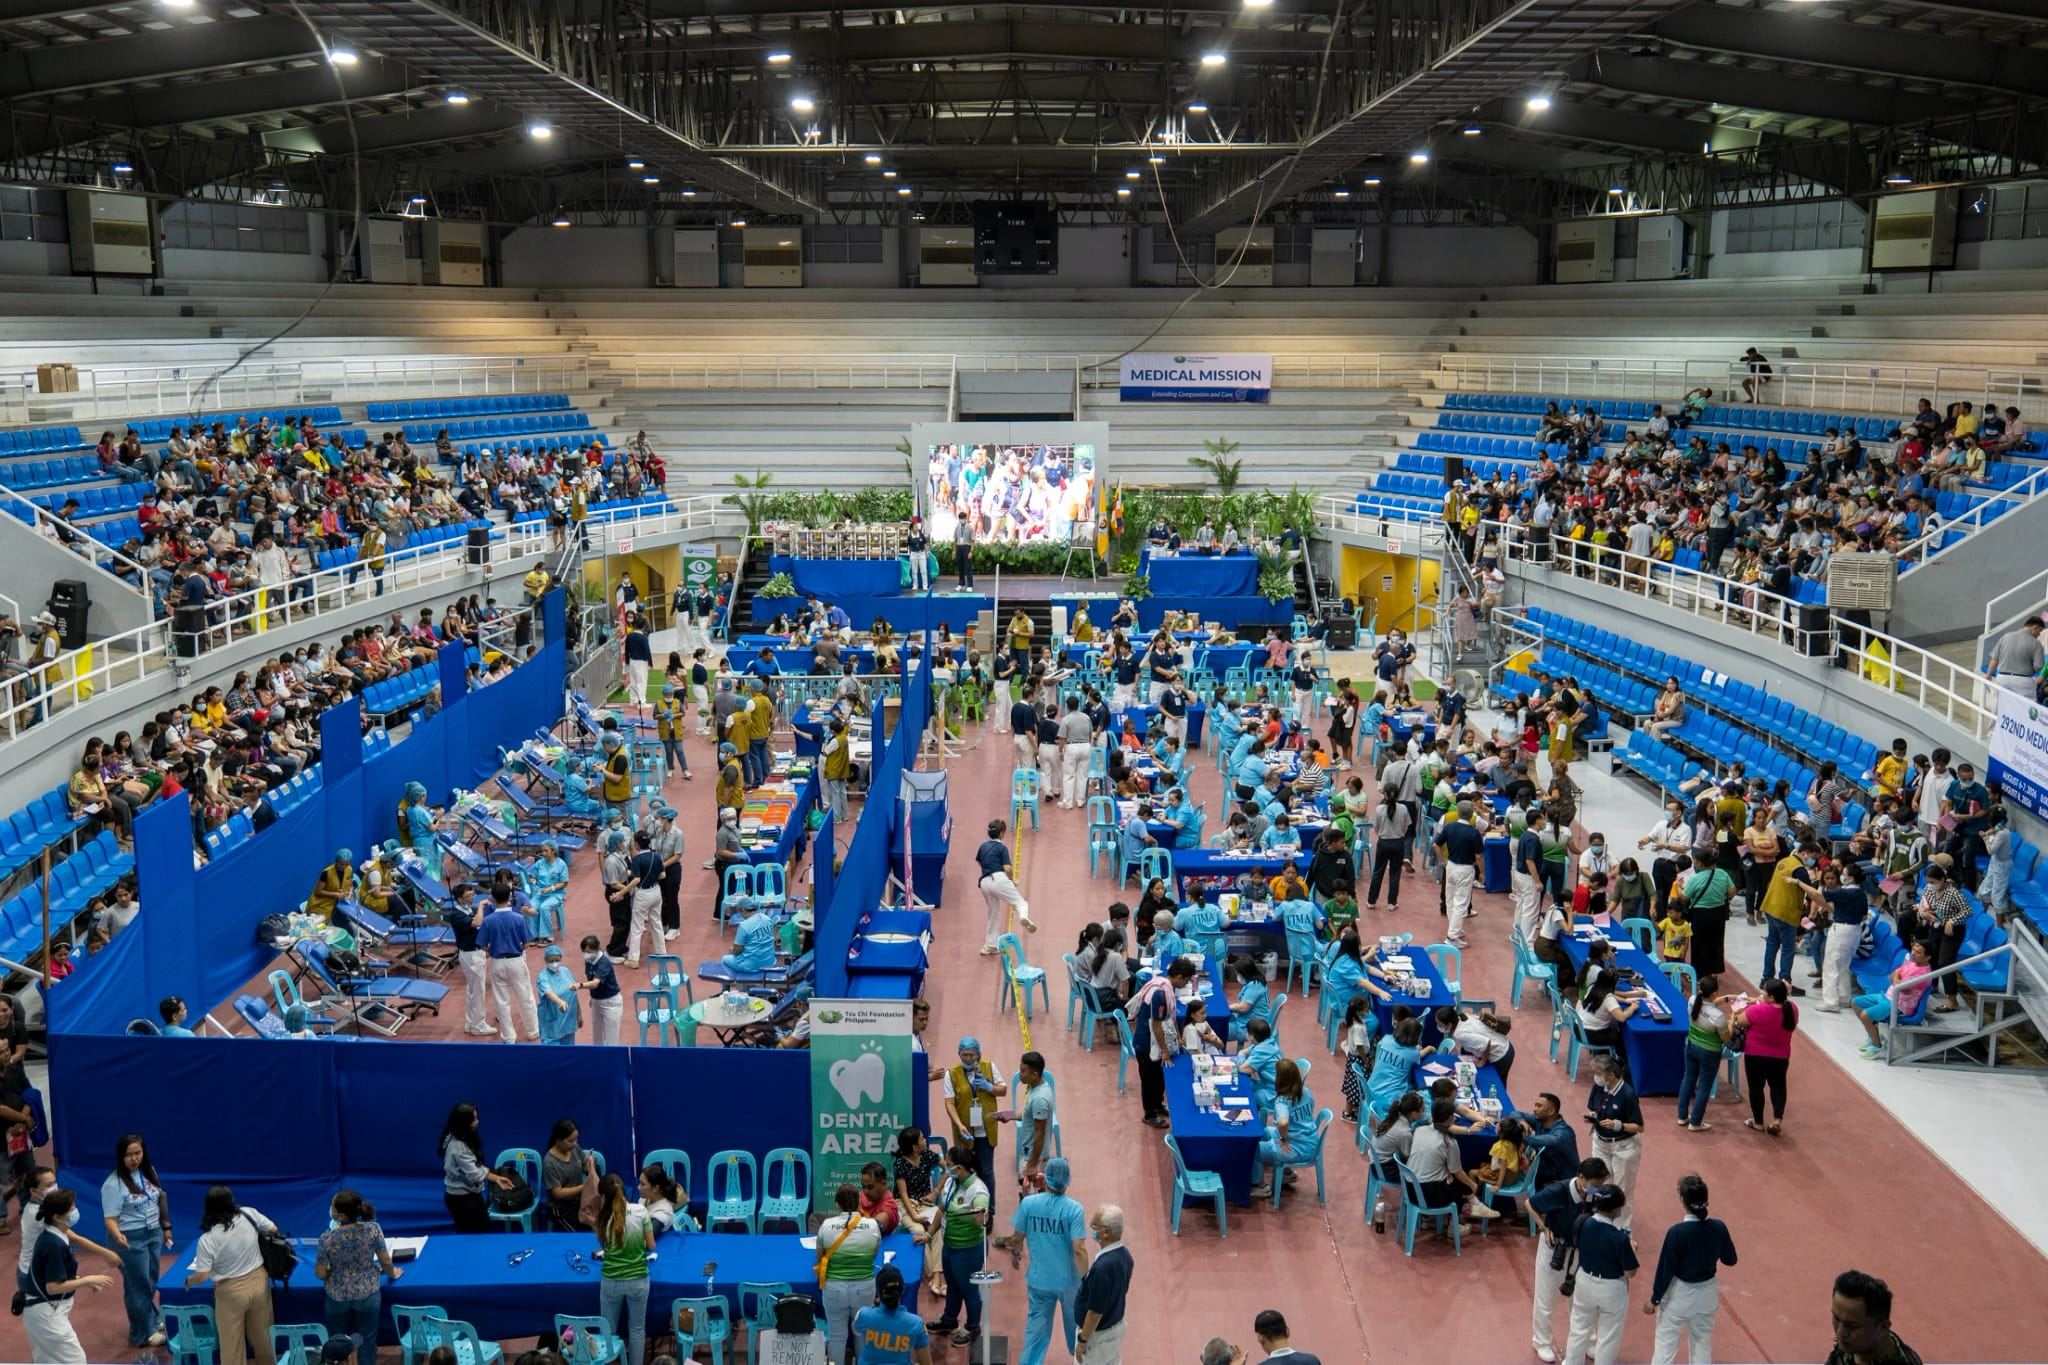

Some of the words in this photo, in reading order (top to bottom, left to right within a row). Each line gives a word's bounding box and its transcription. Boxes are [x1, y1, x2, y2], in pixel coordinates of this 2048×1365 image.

[1130, 370, 1196, 381] MEDICAL
[1200, 370, 1261, 381] MISSION
[1151, 391, 1177, 399] Extending
[1178, 391, 1209, 399] Compassion
[2000, 714, 2025, 740] 292ND
[1191, 912, 1216, 924] TIMA
[1287, 913, 1311, 925] TIMA
[751, 926, 773, 939] TIM
[1379, 1048, 1406, 1070] TIMA
[1291, 1103, 1313, 1121] TIM
[819, 1112, 904, 1129] DENTAL
[820, 1132, 900, 1155] AREA
[1030, 1215, 1065, 1235] TIMA
[772, 1341, 784, 1352] DO
[790, 1341, 811, 1353] NOT
[865, 1328, 910, 1352] PULIS
[772, 1351, 814, 1365] REMOVE
